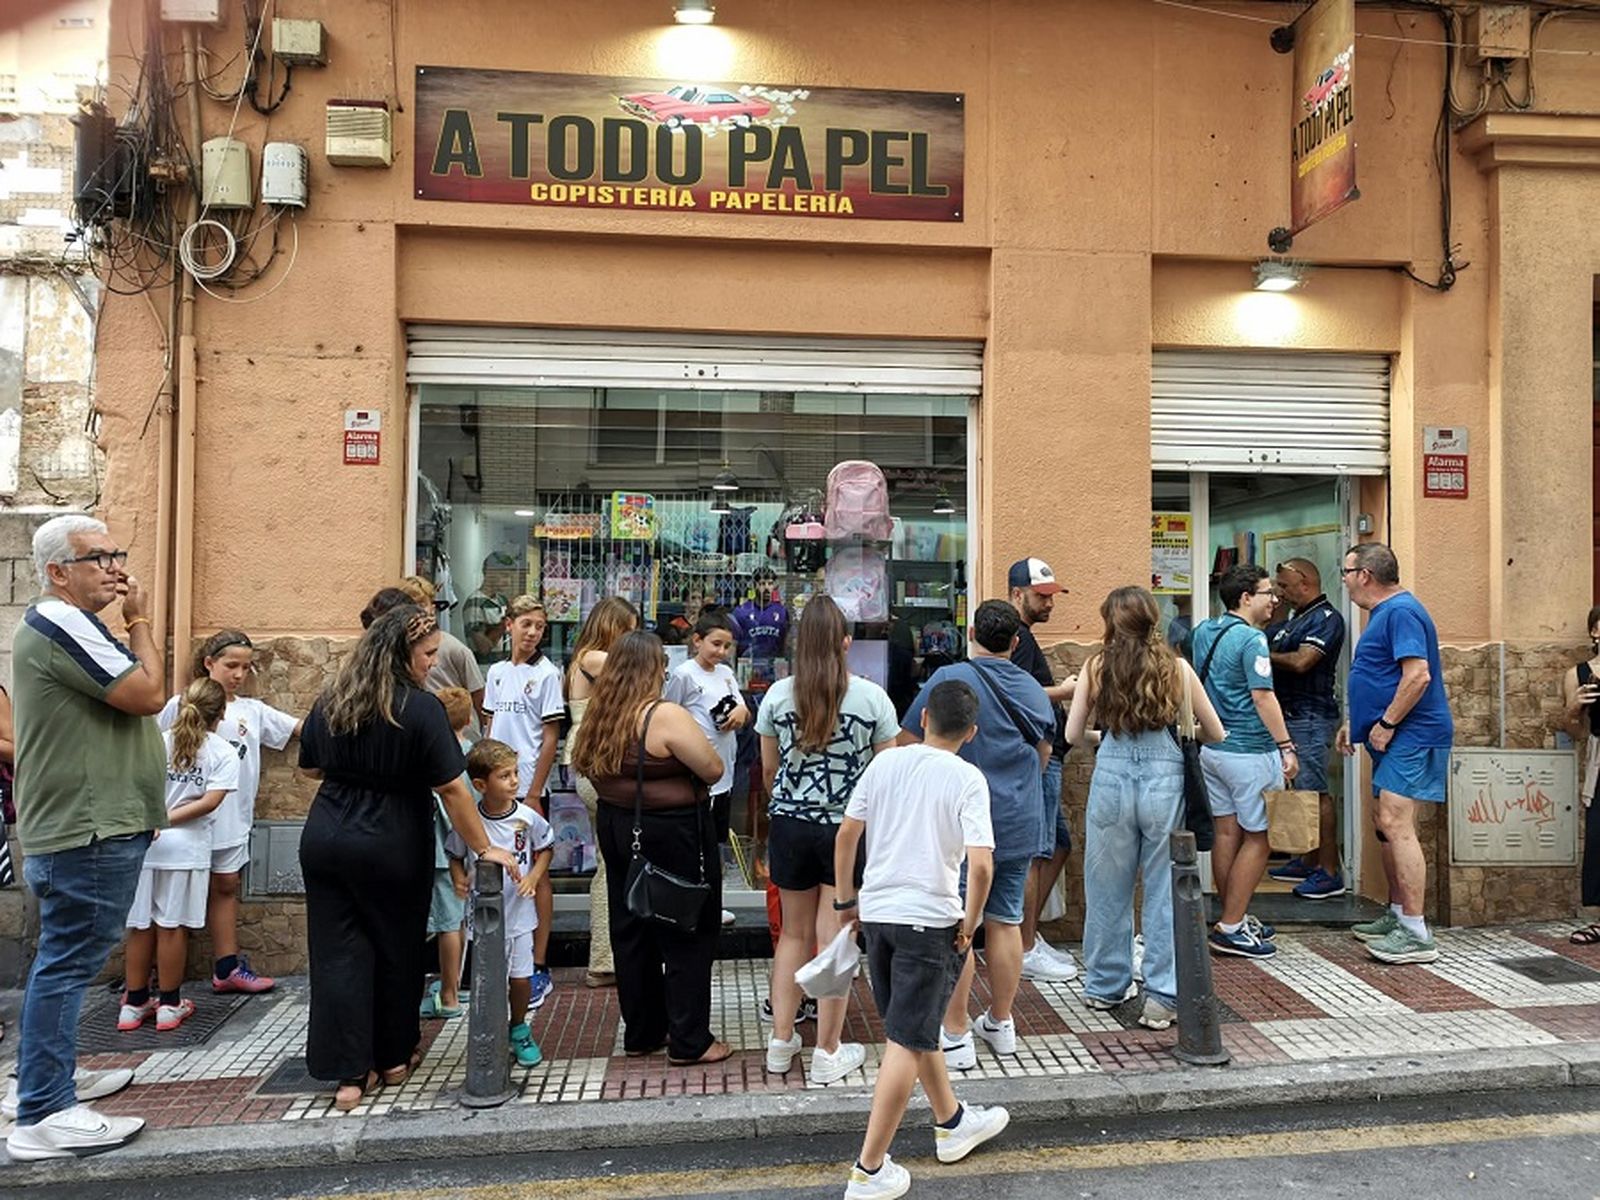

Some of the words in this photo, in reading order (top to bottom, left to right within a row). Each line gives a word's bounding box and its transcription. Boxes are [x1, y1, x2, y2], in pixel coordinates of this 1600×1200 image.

[431, 109, 484, 178] A
[497, 111, 704, 186] TODO
[530, 183, 696, 208] COPISTERÍA
[709, 190, 854, 214] PAPELERÍA
[1427, 456, 1464, 467] Alarma
